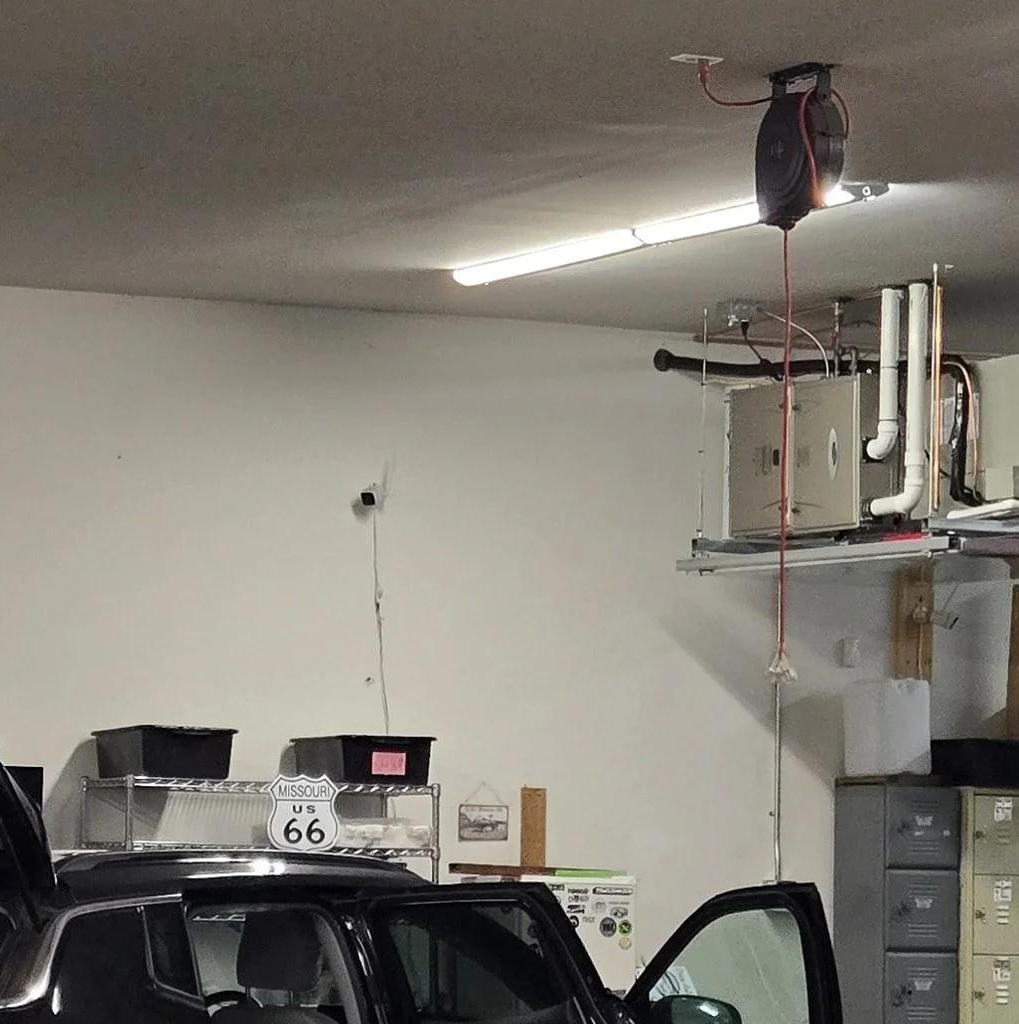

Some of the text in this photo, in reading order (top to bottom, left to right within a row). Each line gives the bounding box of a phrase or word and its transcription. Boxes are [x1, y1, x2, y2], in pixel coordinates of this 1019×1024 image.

[278, 784, 330, 798] MISSOURI
[292, 804, 316, 814] US
[283, 817, 326, 844] 66
